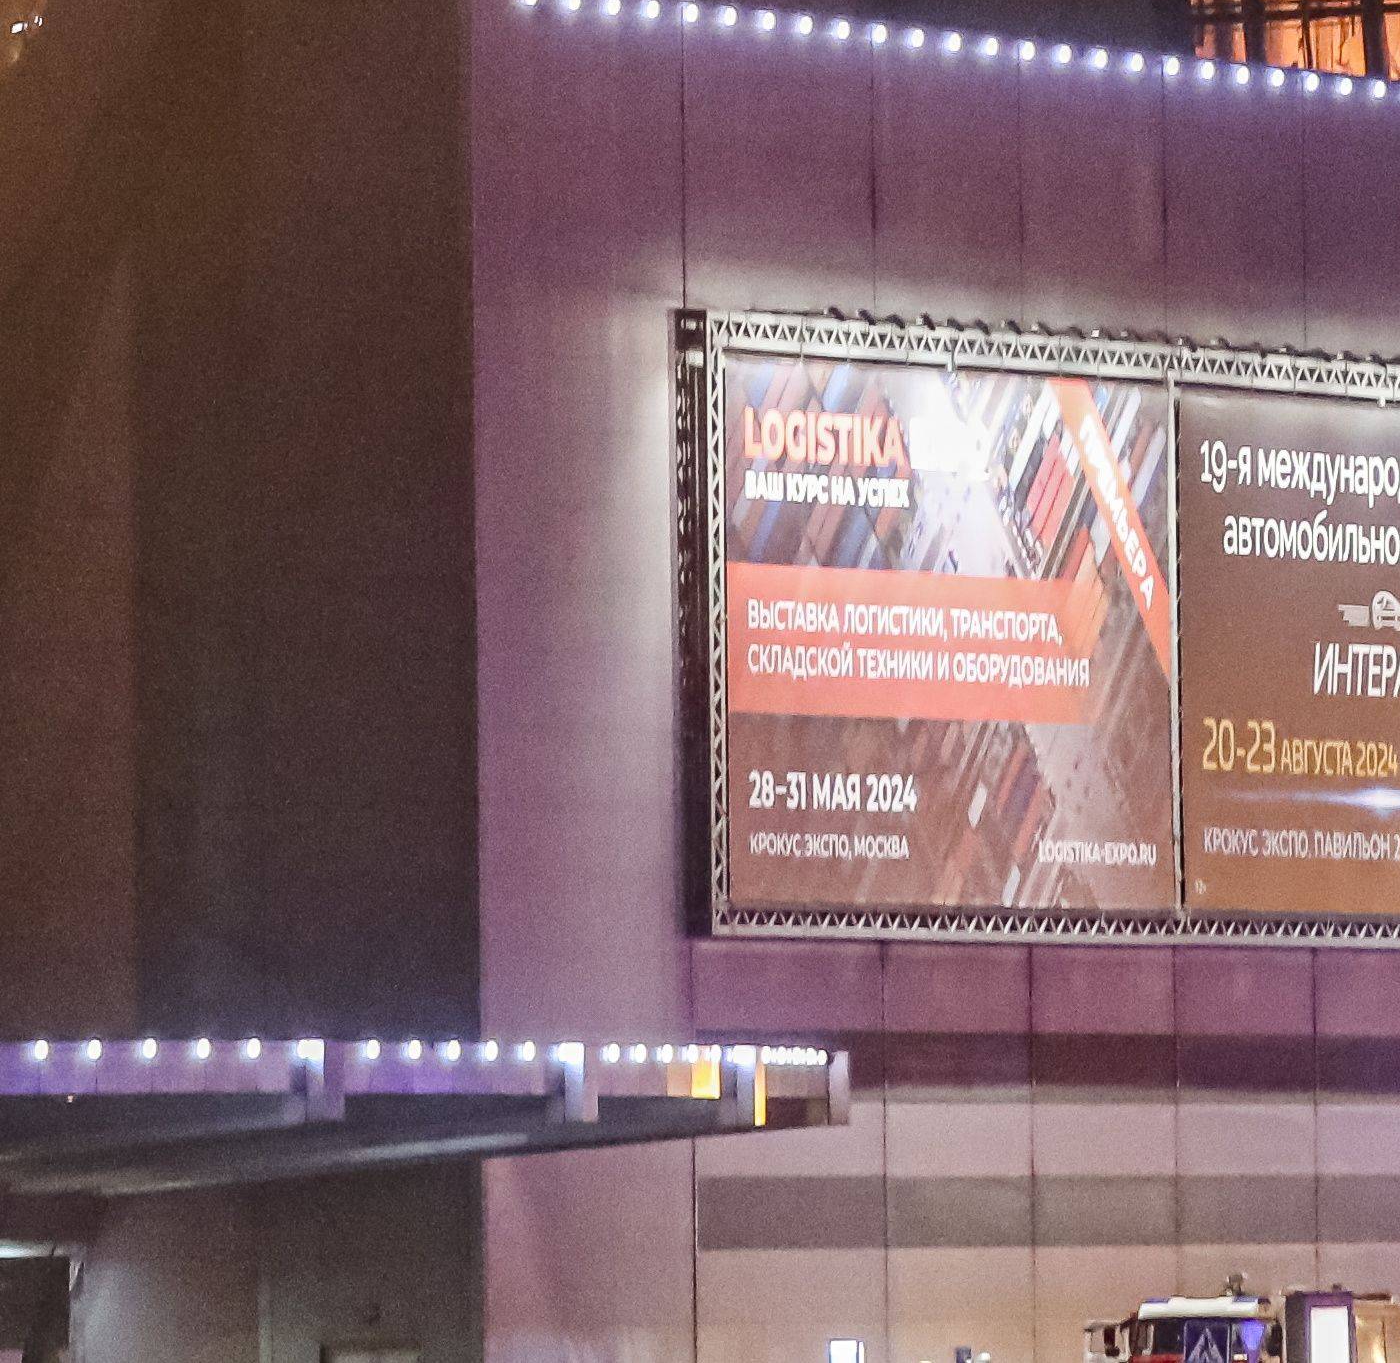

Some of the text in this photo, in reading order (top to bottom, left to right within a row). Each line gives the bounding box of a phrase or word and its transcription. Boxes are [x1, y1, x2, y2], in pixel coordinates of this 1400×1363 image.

[744, 405, 911, 477] LOGISTIKA
[745, 469, 784, 501] ВАШ
[786, 472, 829, 505] КУРС
[831, 475, 856, 506] НА
[1200, 439, 1251, 494] 19-я
[747, 598, 1064, 647] ВЫСТАВКА ЛОГИСТИКИ, ТРАНСПОРТА,
[747, 641, 1090, 689] СКЛАДСКОЙ ТЕХНИКИ И ОБОРУДОВАНИЯ
[1203, 717, 1399, 778] 20-23 АВГУСТА 2024
[749, 769, 918, 813] 28-31 МАЯ 2024
[750, 831, 910, 861] КРОКУС ЭКСПО, МОСКВА
[1038, 840, 1157, 867] LOGISTIKA-EXPO.RU
[1203, 826, 1258, 856] КРОКУС
[1314, 829, 1391, 861] ПАВИЛЬОН
[1394, 833, 1400, 862] 2
